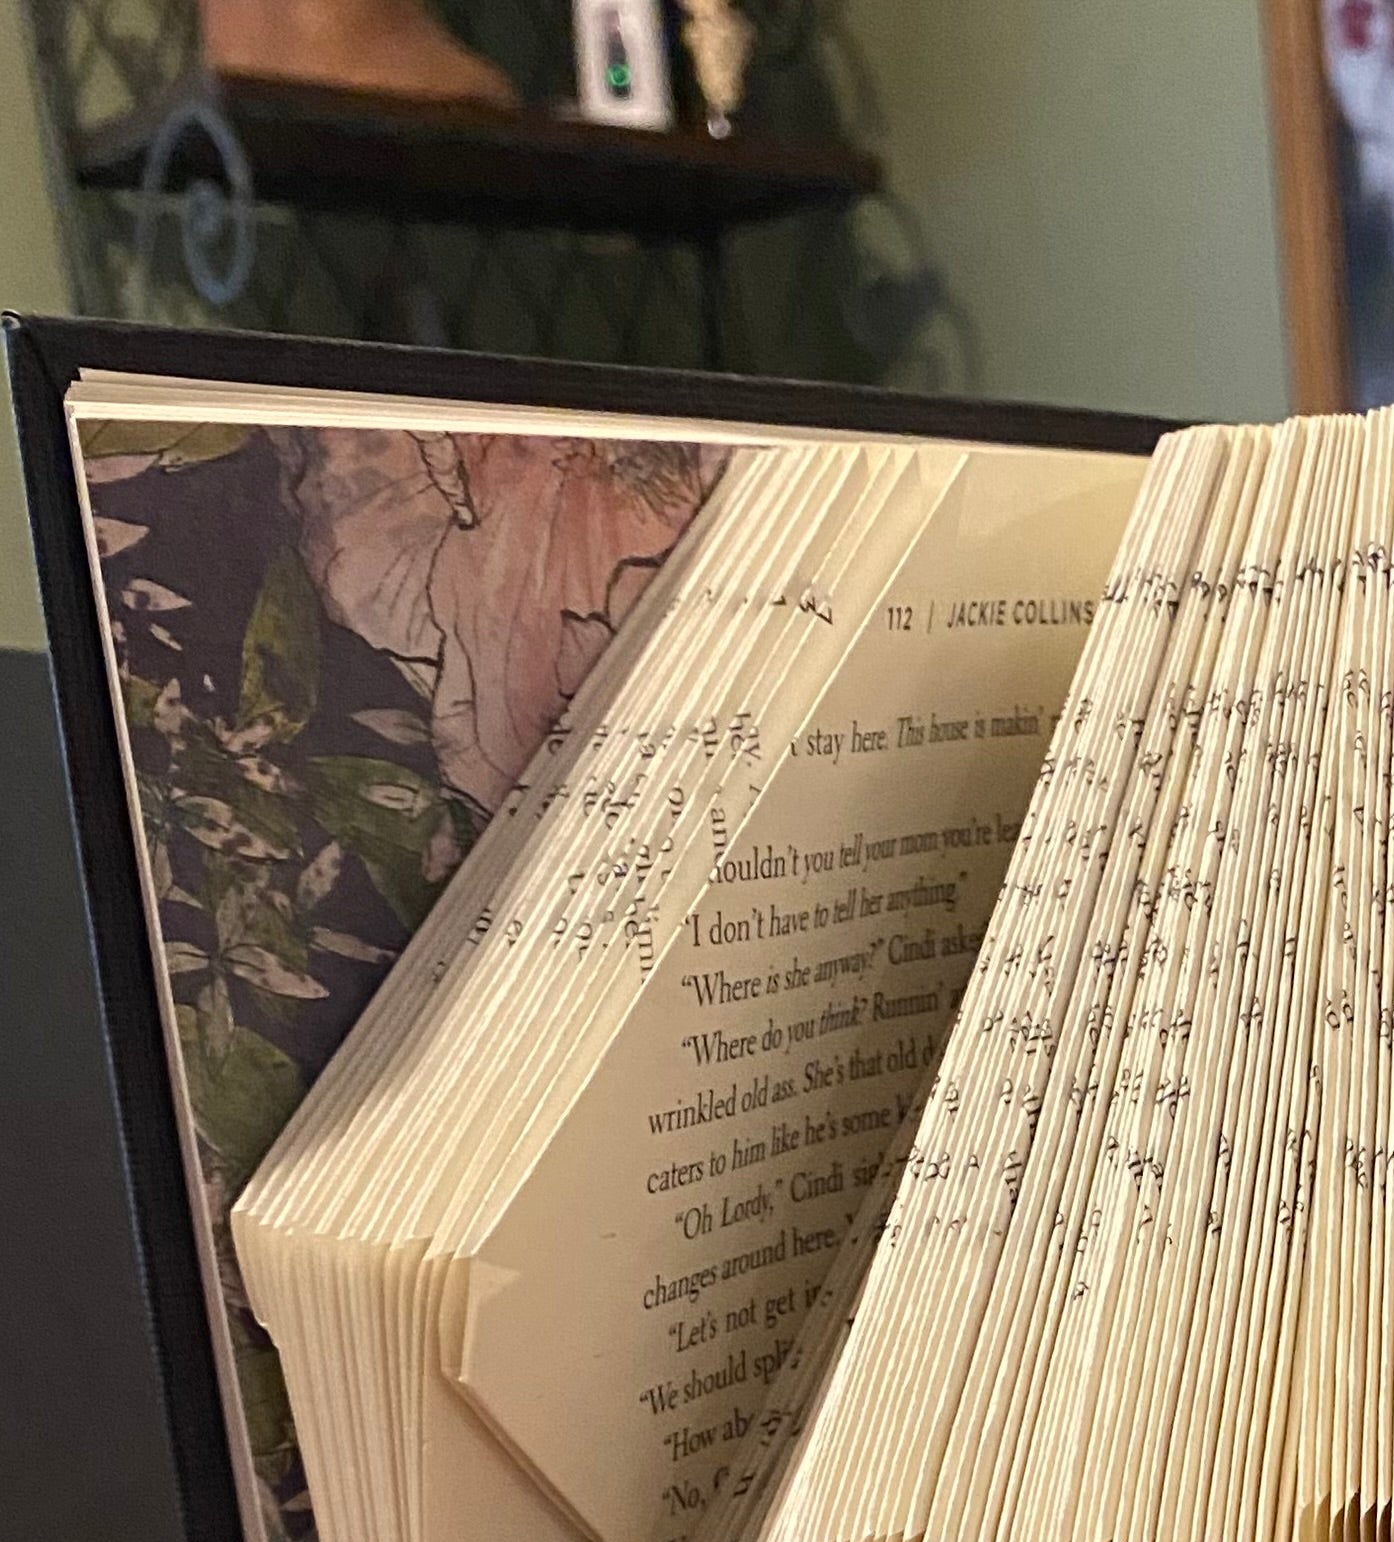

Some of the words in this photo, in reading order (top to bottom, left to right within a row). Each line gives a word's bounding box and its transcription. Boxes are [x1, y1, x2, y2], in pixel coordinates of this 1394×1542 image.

[888, 606, 913, 631] 112
[947, 600, 1006, 628] JACKIE
[1012, 600, 1094, 626] COLLINS
[807, 727, 844, 766] stay
[851, 720, 888, 753] here.
[897, 712, 925, 748] This
[929, 712, 969, 744] house
[975, 710, 986, 739] is
[804, 851, 834, 885] you
[839, 831, 864, 870] tell
[862, 837, 897, 873] your
[709, 907, 764, 946] don't
[769, 903, 808, 938] have
[814, 903, 829, 928] to
[832, 887, 854, 925] tell
[859, 886, 883, 918] her
[681, 970, 761, 1008] "Where
[766, 963, 780, 995] is
[783, 957, 811, 992] she
[888, 928, 936, 966] Cindi
[681, 1028, 756, 1067] "Where
[762, 1018, 782, 1051] do
[787, 1018, 816, 1054] you
[648, 1084, 736, 1135] wrinkled
[741, 1074, 768, 1113] old
[803, 1054, 845, 1094] She's
[849, 1048, 881, 1083] that
[887, 1040, 916, 1073] old
[647, 1159, 704, 1195] caters
[709, 1149, 726, 1177] to
[732, 1139, 766, 1171] him
[771, 1122, 800, 1156] like
[804, 1111, 839, 1147] he's
[842, 1108, 891, 1137] some
[675, 1203, 713, 1240] "Oh
[790, 1161, 844, 1204] Cindi
[643, 1263, 717, 1310] changes
[721, 1230, 786, 1281] around
[669, 1311, 717, 1353] "Let's
[725, 1297, 757, 1333] not
[766, 1286, 796, 1330] get
[639, 1381, 678, 1416] "We
[683, 1350, 747, 1404] should
[664, 1427, 718, 1462] "How
